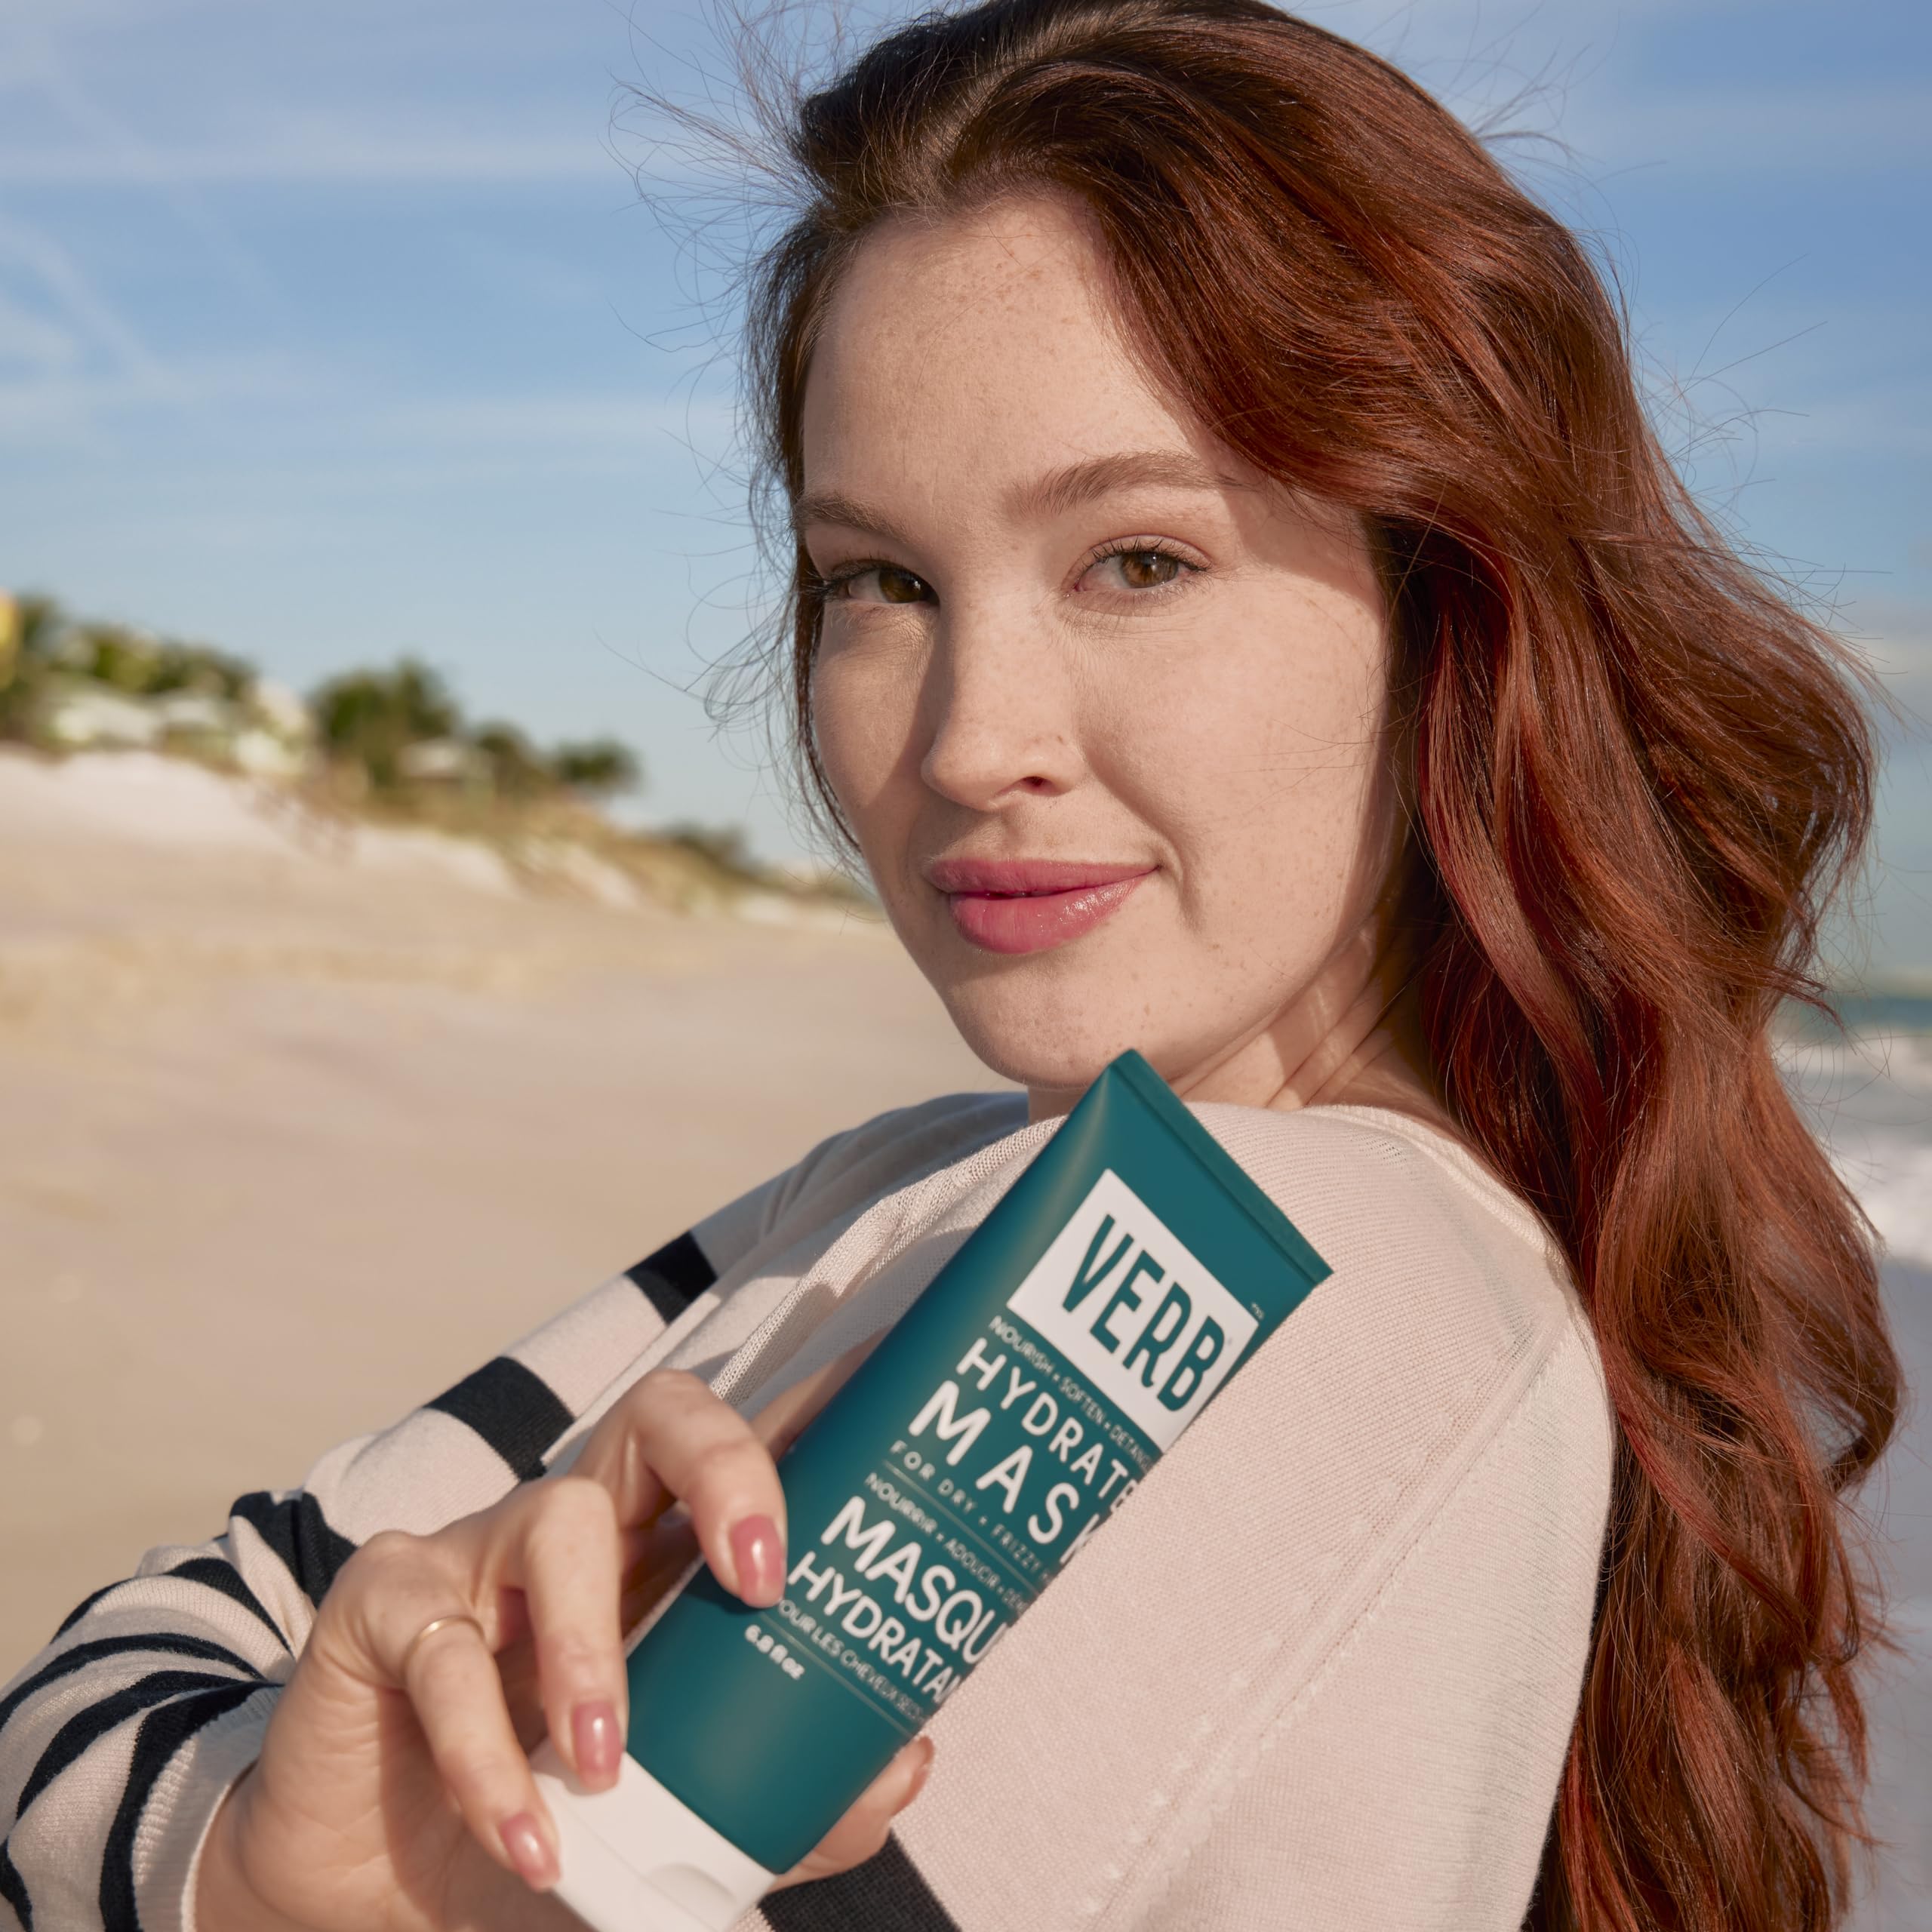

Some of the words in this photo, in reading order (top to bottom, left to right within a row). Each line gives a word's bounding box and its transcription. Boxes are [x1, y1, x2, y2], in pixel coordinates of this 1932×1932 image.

[1062, 1214, 1224, 1412] VERB
[955, 1337, 1138, 1510] HYDRATE
[989, 1315, 1054, 1374] NOURISH
[1058, 1376, 1107, 1430] SOFTEN
[865, 1472, 938, 1535] NOURRIR
[944, 1538, 1001, 1589] ADOUCIR
[889, 1439, 936, 1481] FOR
[937, 1478, 978, 1514] DRY
[989, 1523, 1042, 1572] FRIZZY
[744, 1623, 775, 1654] 6.8
[778, 1598, 817, 1634] OUR
[811, 1625, 844, 1657] LES
